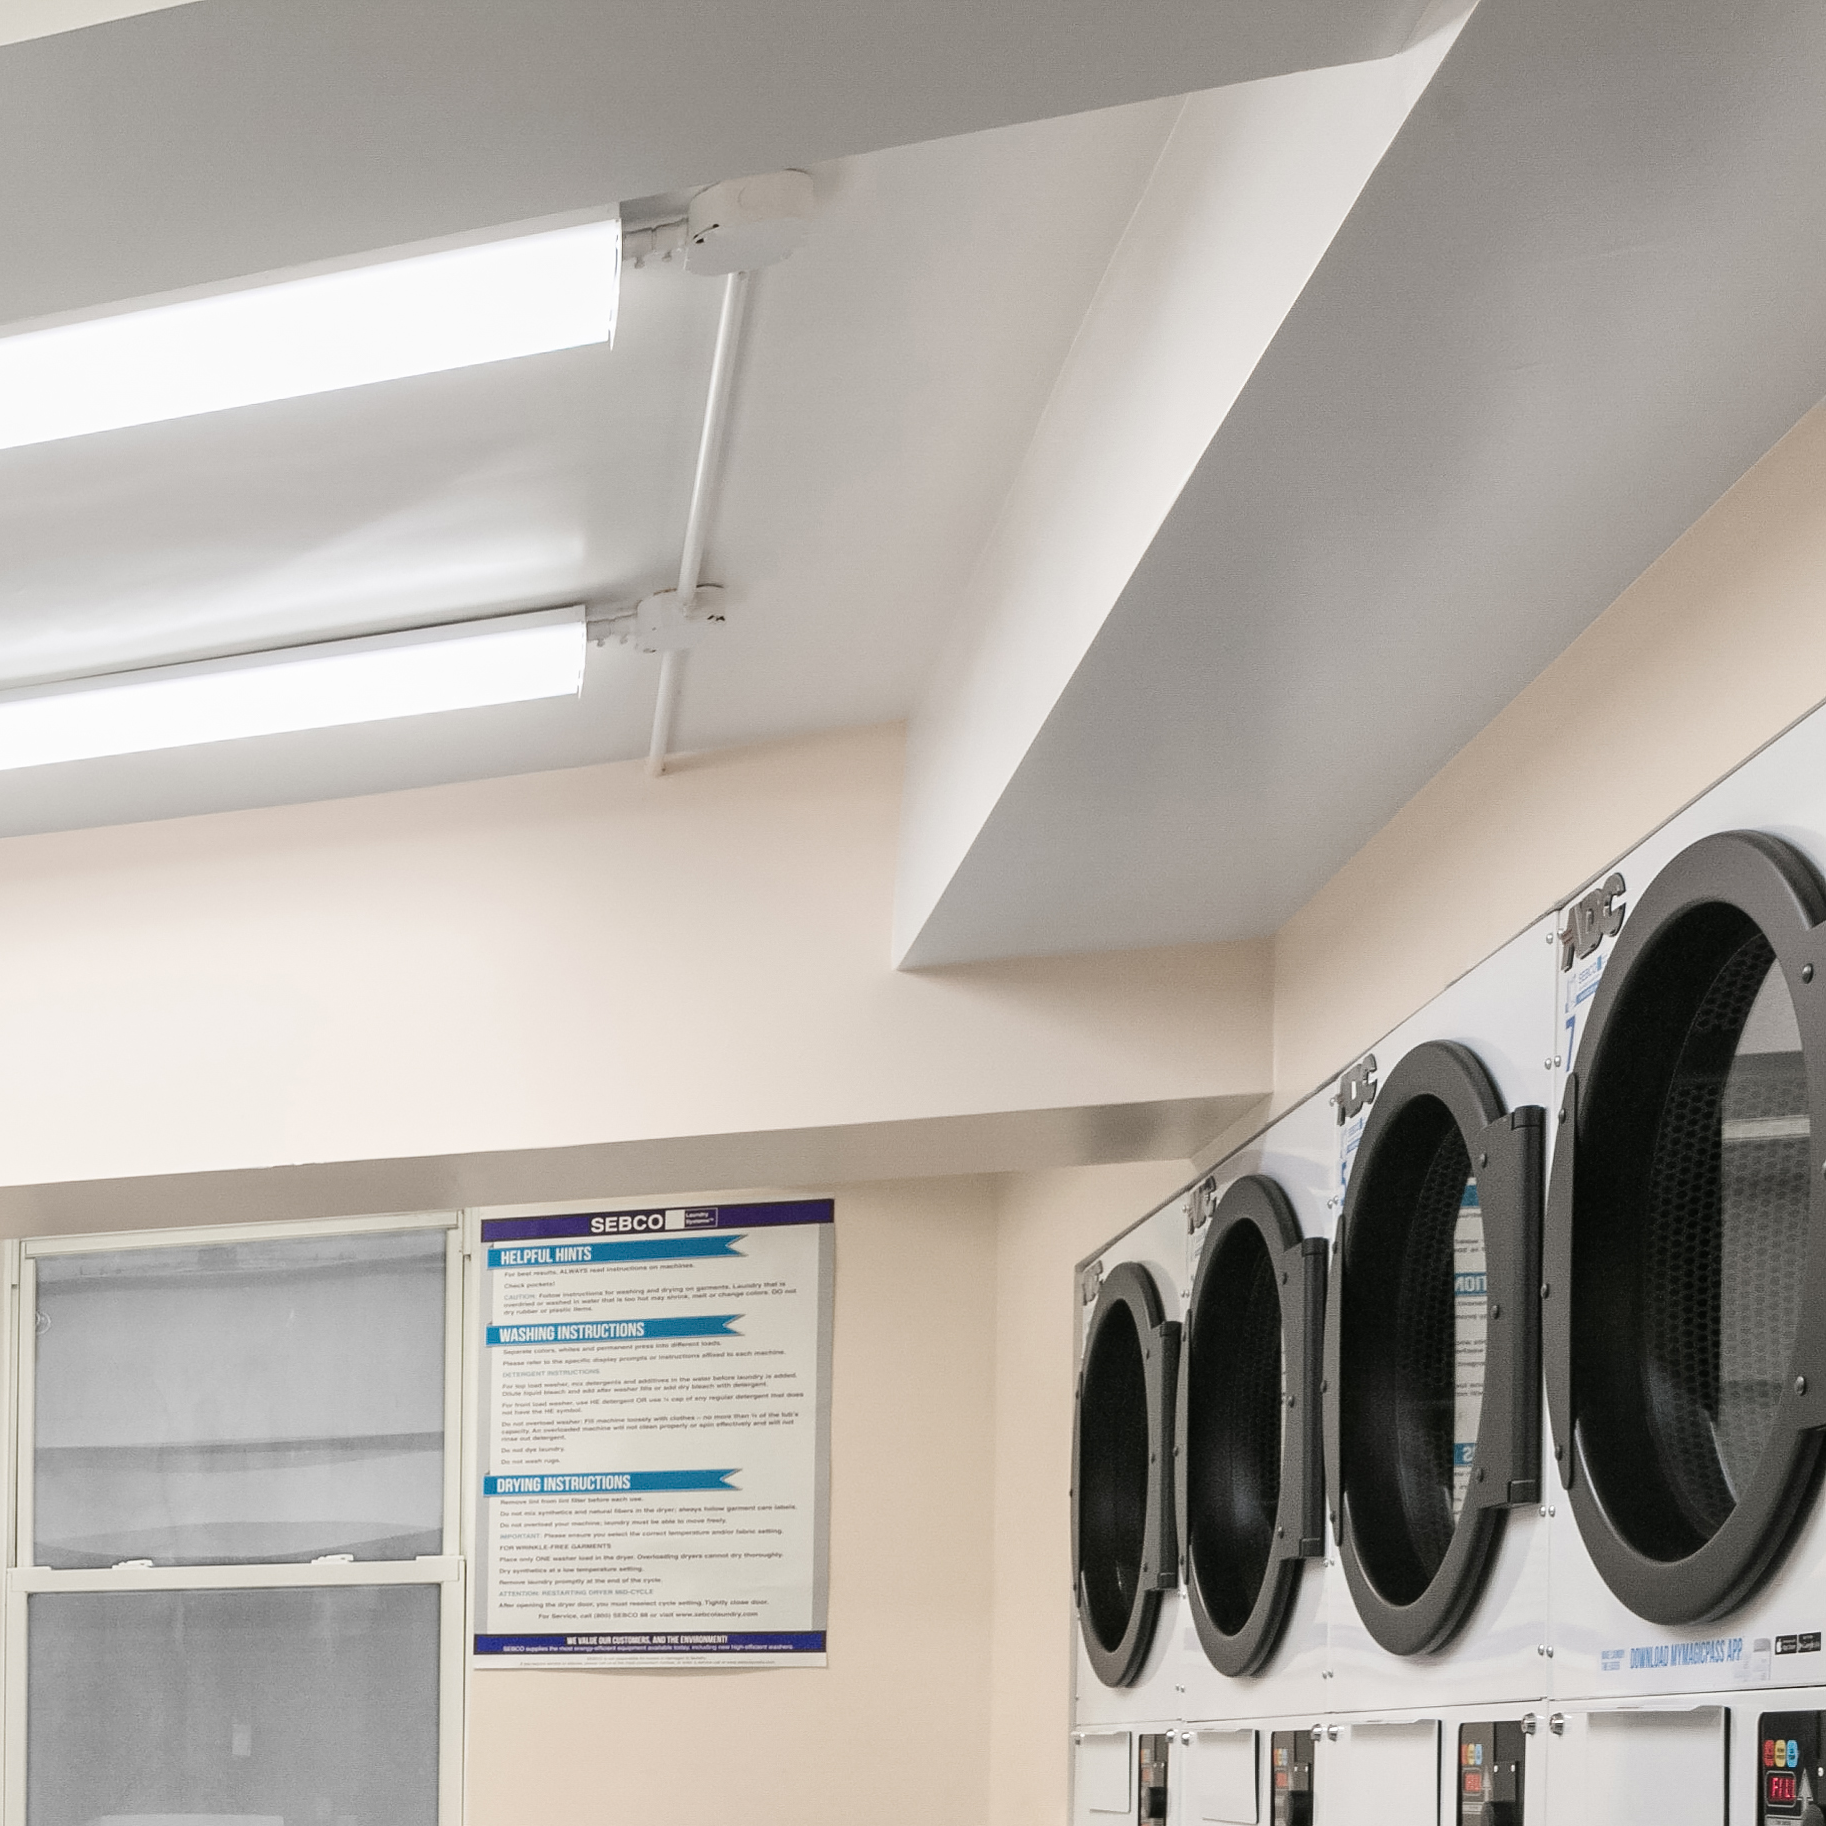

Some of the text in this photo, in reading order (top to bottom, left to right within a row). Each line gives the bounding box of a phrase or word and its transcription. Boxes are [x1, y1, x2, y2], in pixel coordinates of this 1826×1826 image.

[1560, 872, 1626, 973] ADC
[1566, 1015, 1576, 1072] 7
[1336, 1053, 1377, 1126] ADC
[591, 1214, 663, 1233] SEBCO
[501, 1246, 592, 1265] HELPFUL HINTS
[500, 1322, 645, 1342] WASHING INSTRUCTIONS
[497, 1475, 630, 1492] DRYING INSTRUCTIONS
[1629, 1645, 1669, 1669] DOWNLOAD
[1670, 1640, 1725, 1666] MYMAGICPASS
[1726, 1638, 1743, 1662] APP
